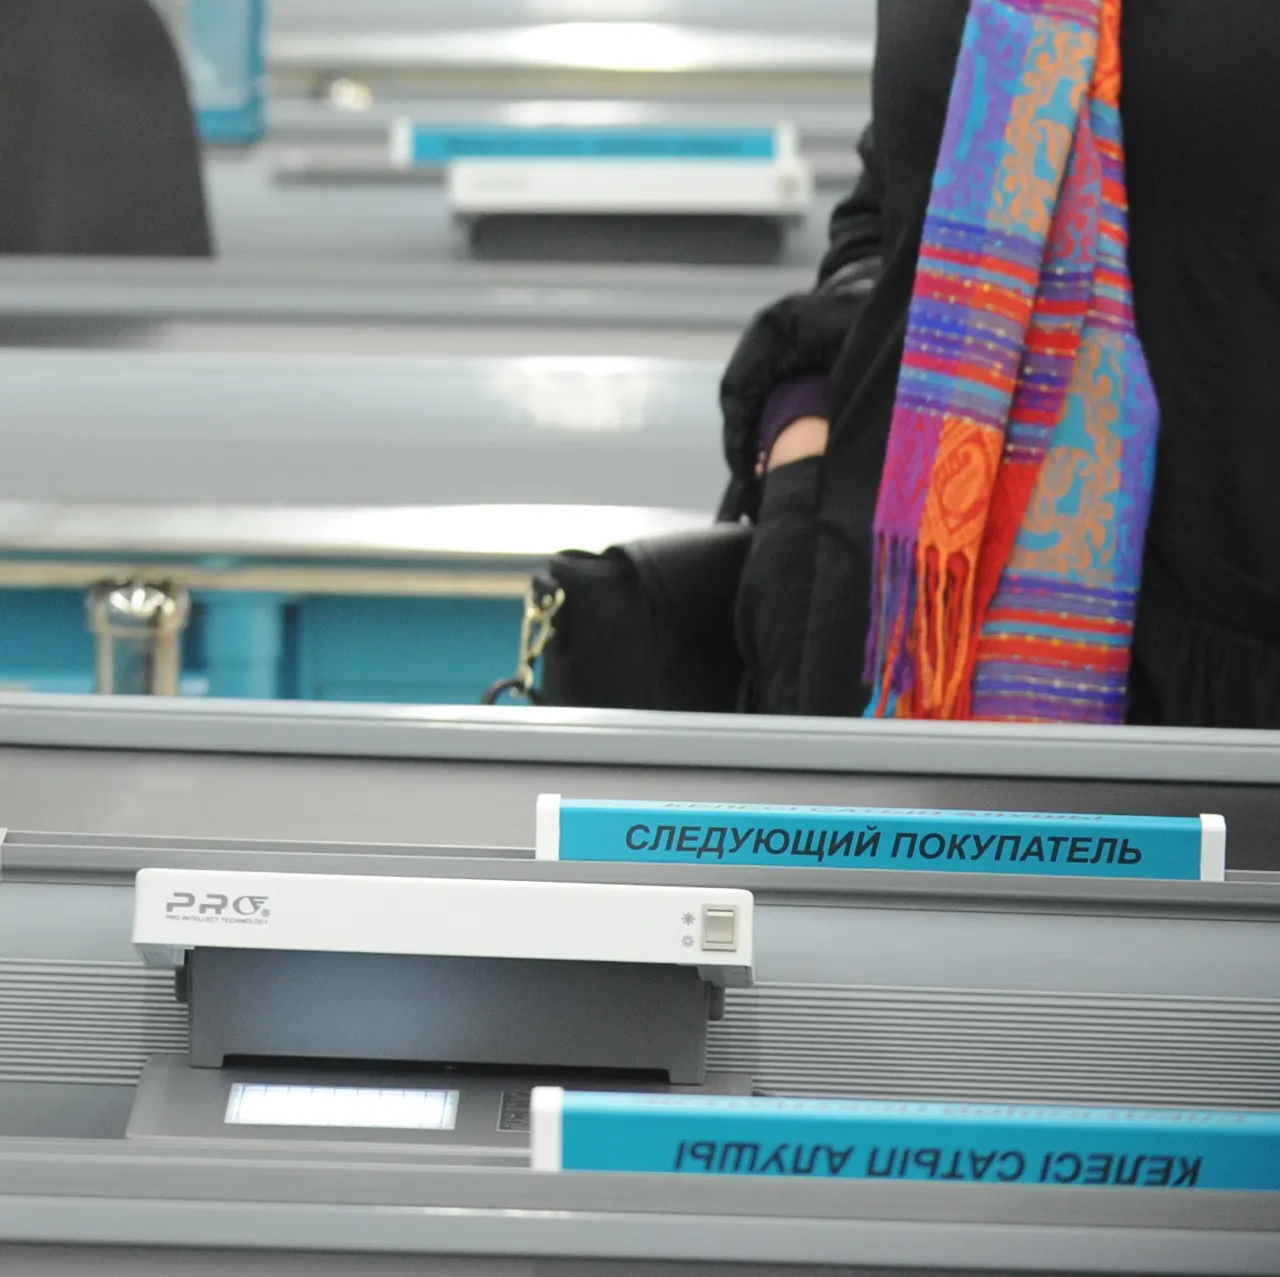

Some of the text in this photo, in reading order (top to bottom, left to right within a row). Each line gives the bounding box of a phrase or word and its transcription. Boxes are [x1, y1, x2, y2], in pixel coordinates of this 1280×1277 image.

[626, 824, 1142, 865] СЛЕДУЮЩИЙ ПОКУПАТЕЛЬ
[674, 1138, 1204, 1188] КЕЛЕСІ САТЫП АЛУШЫ
